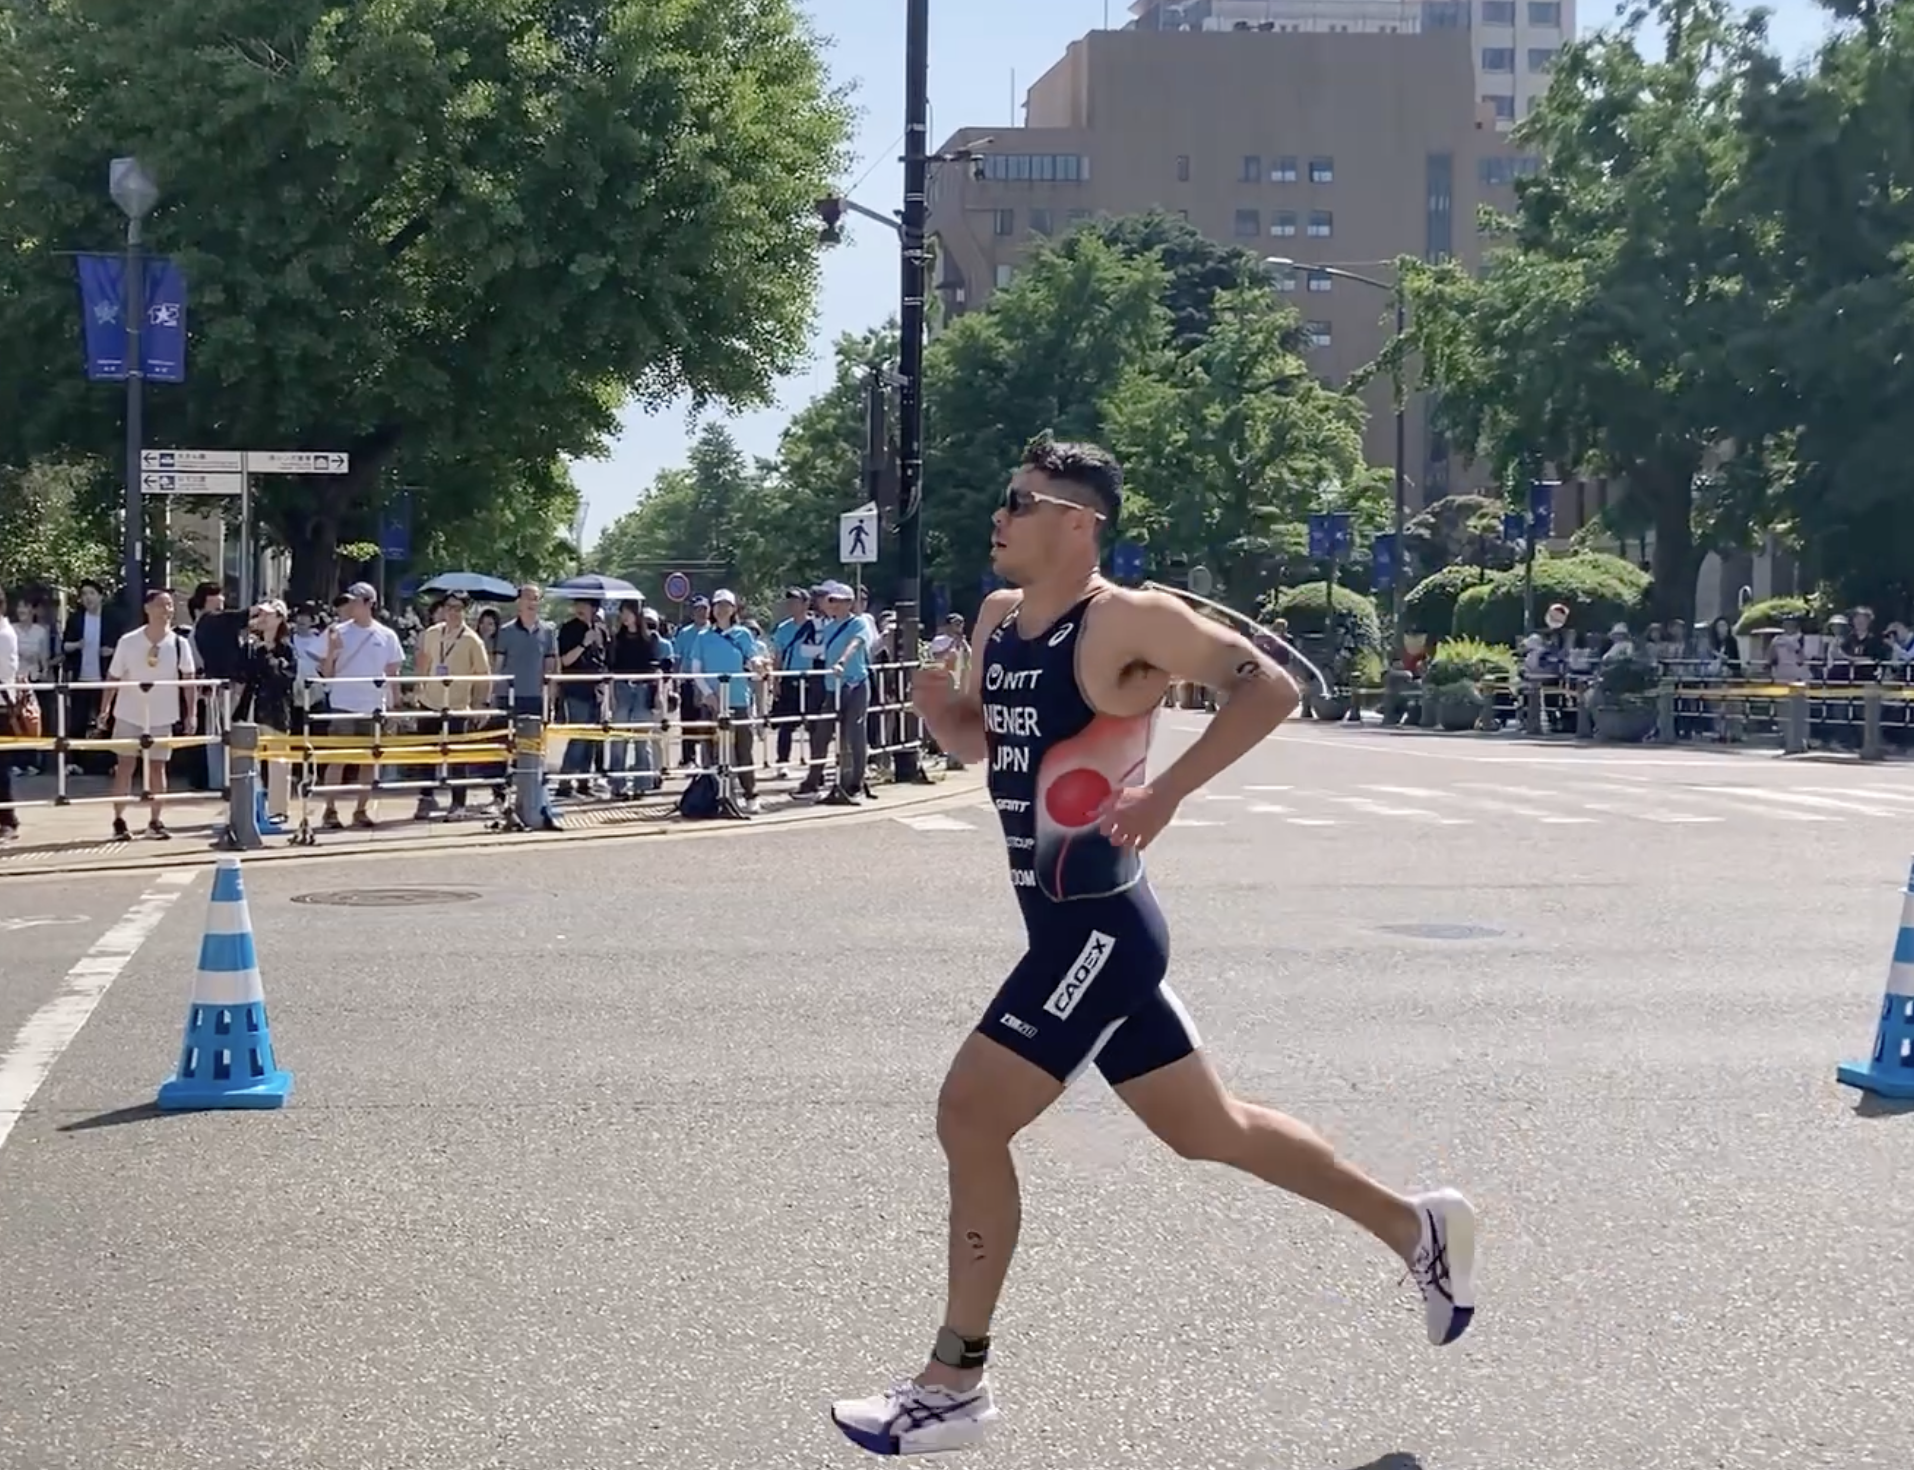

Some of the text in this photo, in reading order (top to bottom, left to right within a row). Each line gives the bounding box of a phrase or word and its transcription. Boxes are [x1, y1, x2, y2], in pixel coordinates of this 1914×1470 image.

[1003, 669, 1043, 690] NTT
[992, 744, 1030, 772] JPN
[1054, 937, 1107, 1013] CADEX
